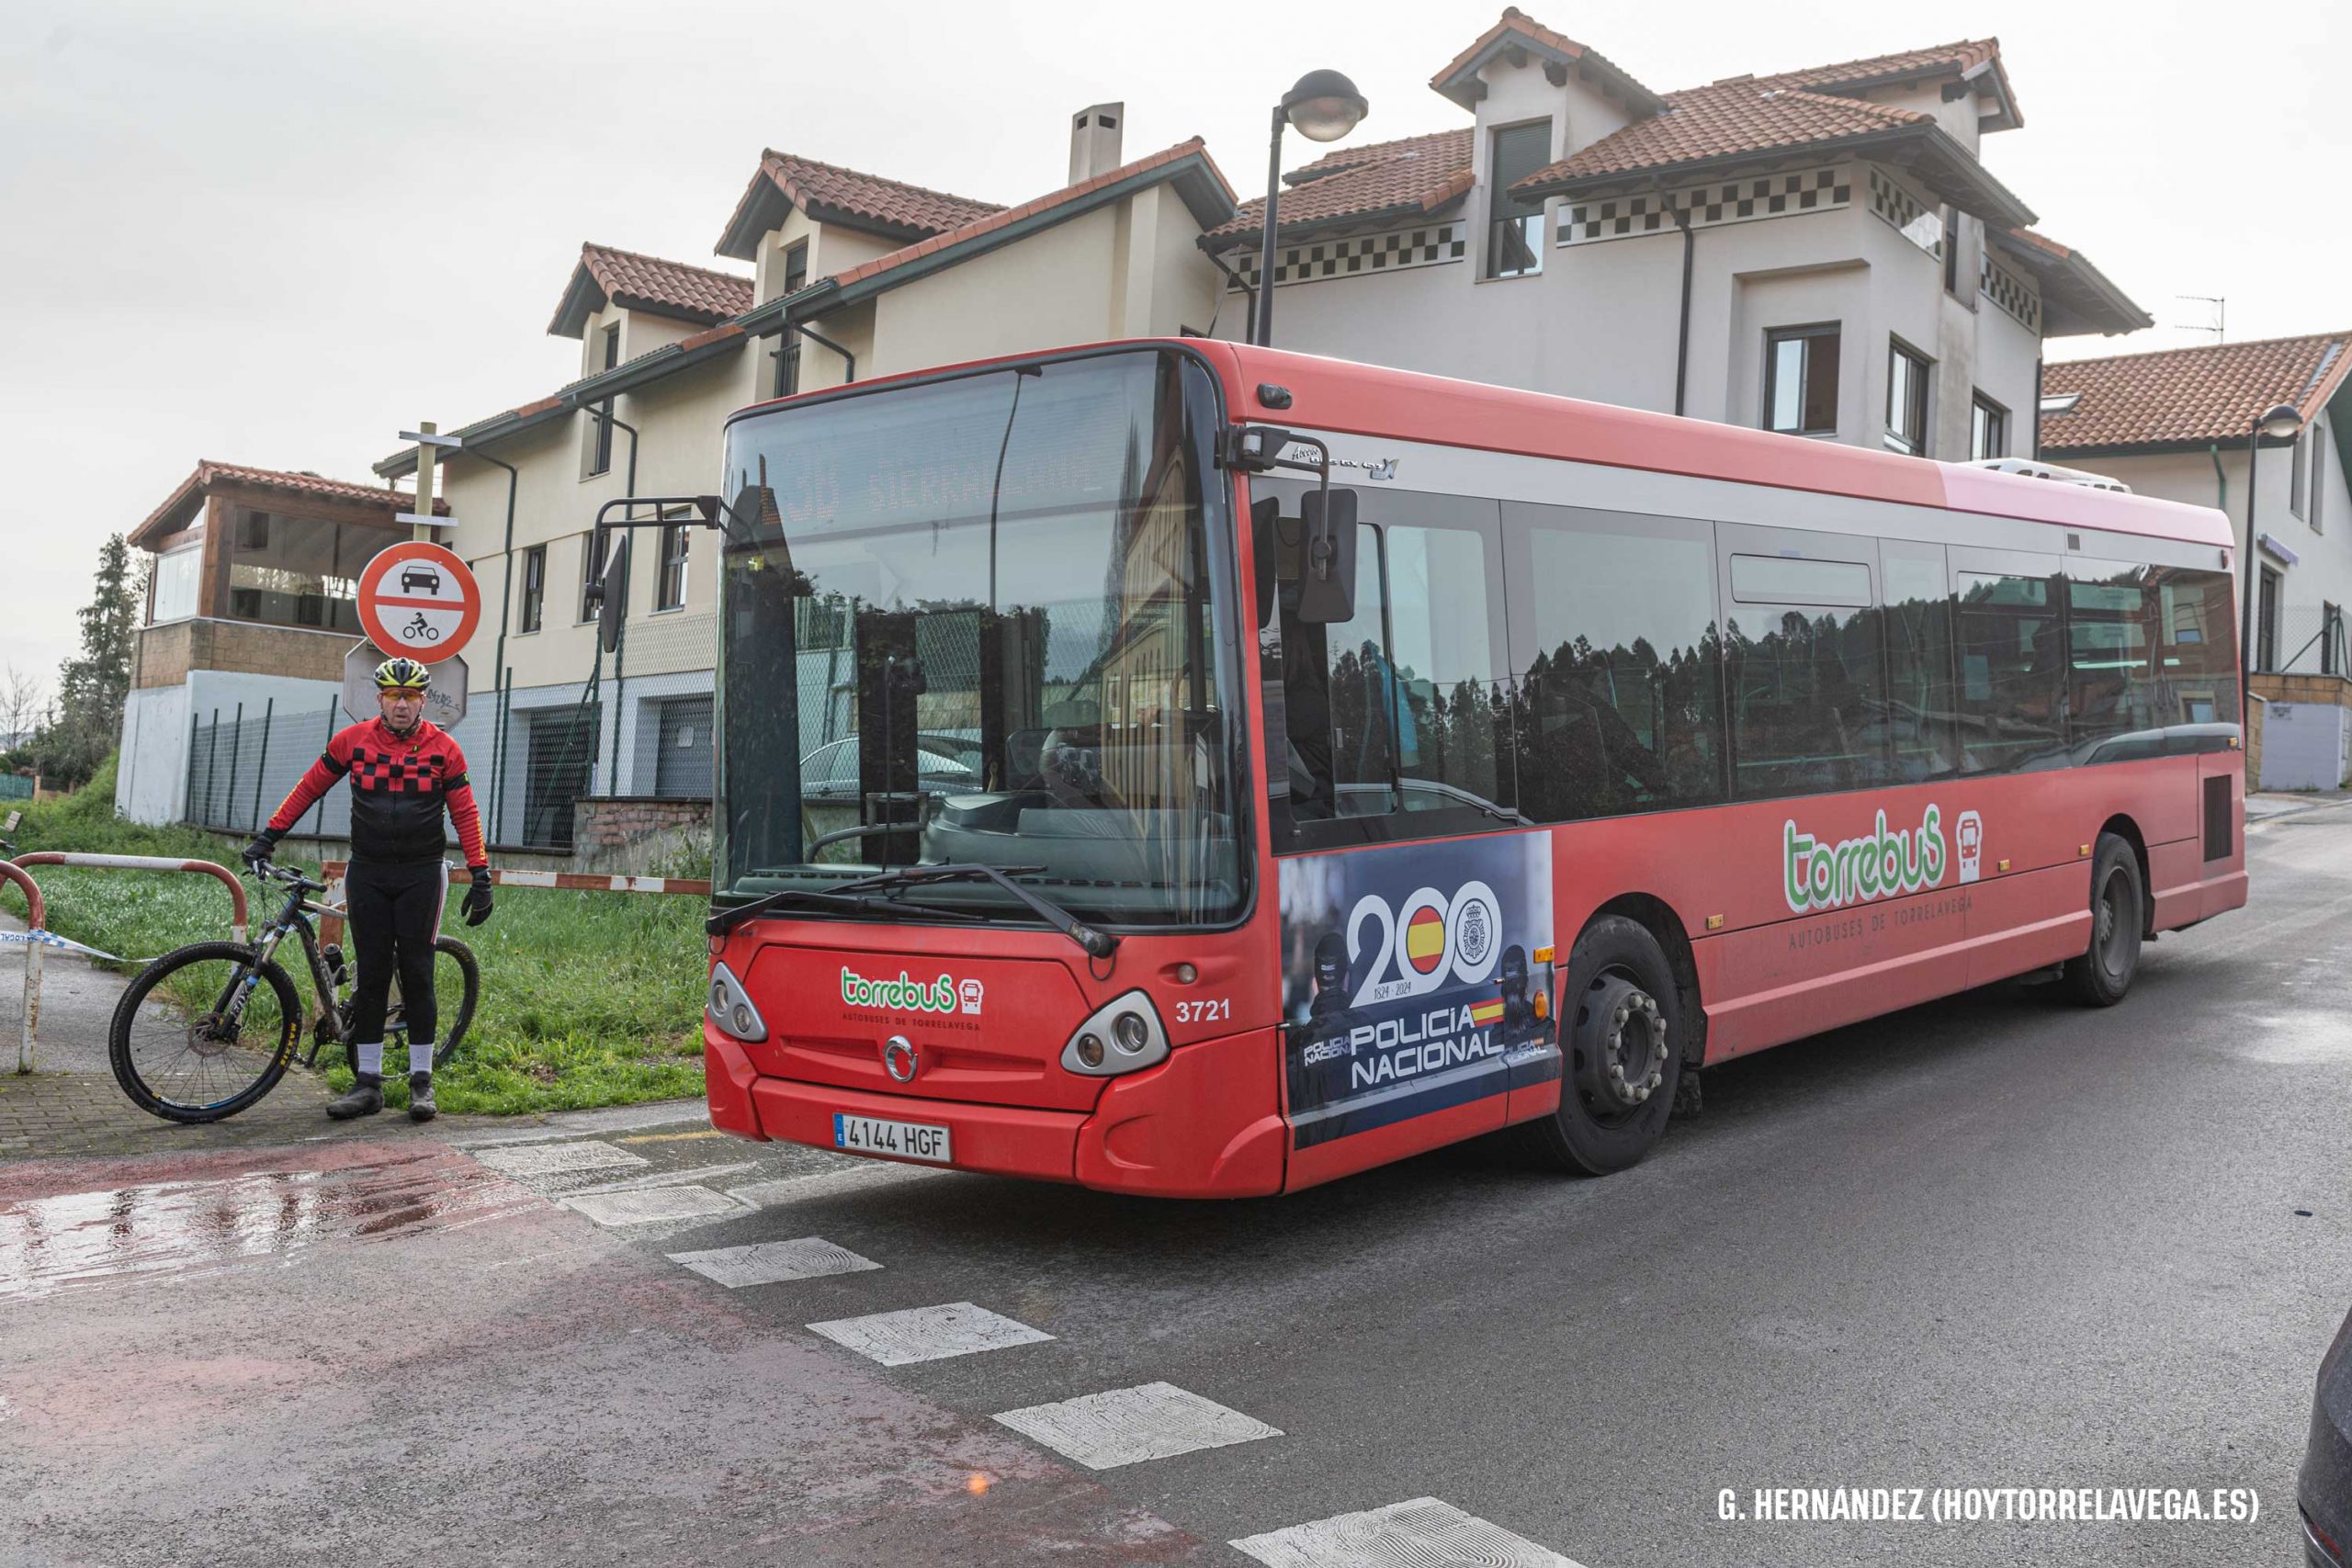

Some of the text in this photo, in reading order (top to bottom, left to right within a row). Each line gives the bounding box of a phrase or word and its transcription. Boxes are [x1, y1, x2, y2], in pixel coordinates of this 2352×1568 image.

[1790, 897, 1973, 950] AUTOBUSES DE TORRELAVEGA
[1346, 880, 1502, 1009] 200
[1176, 998, 1230, 1022] 3721
[1374, 981, 1411, 1000] 1824 2024
[842, 1013, 980, 1032] AUTOBUSES DE TORRELAVEGA
[280, 1021, 297, 1066] MAXXIS
[1351, 1030, 1506, 1089] NACIONAL
[849, 1120, 897, 1151] 4144
[904, 1126, 943, 1156] HGF
